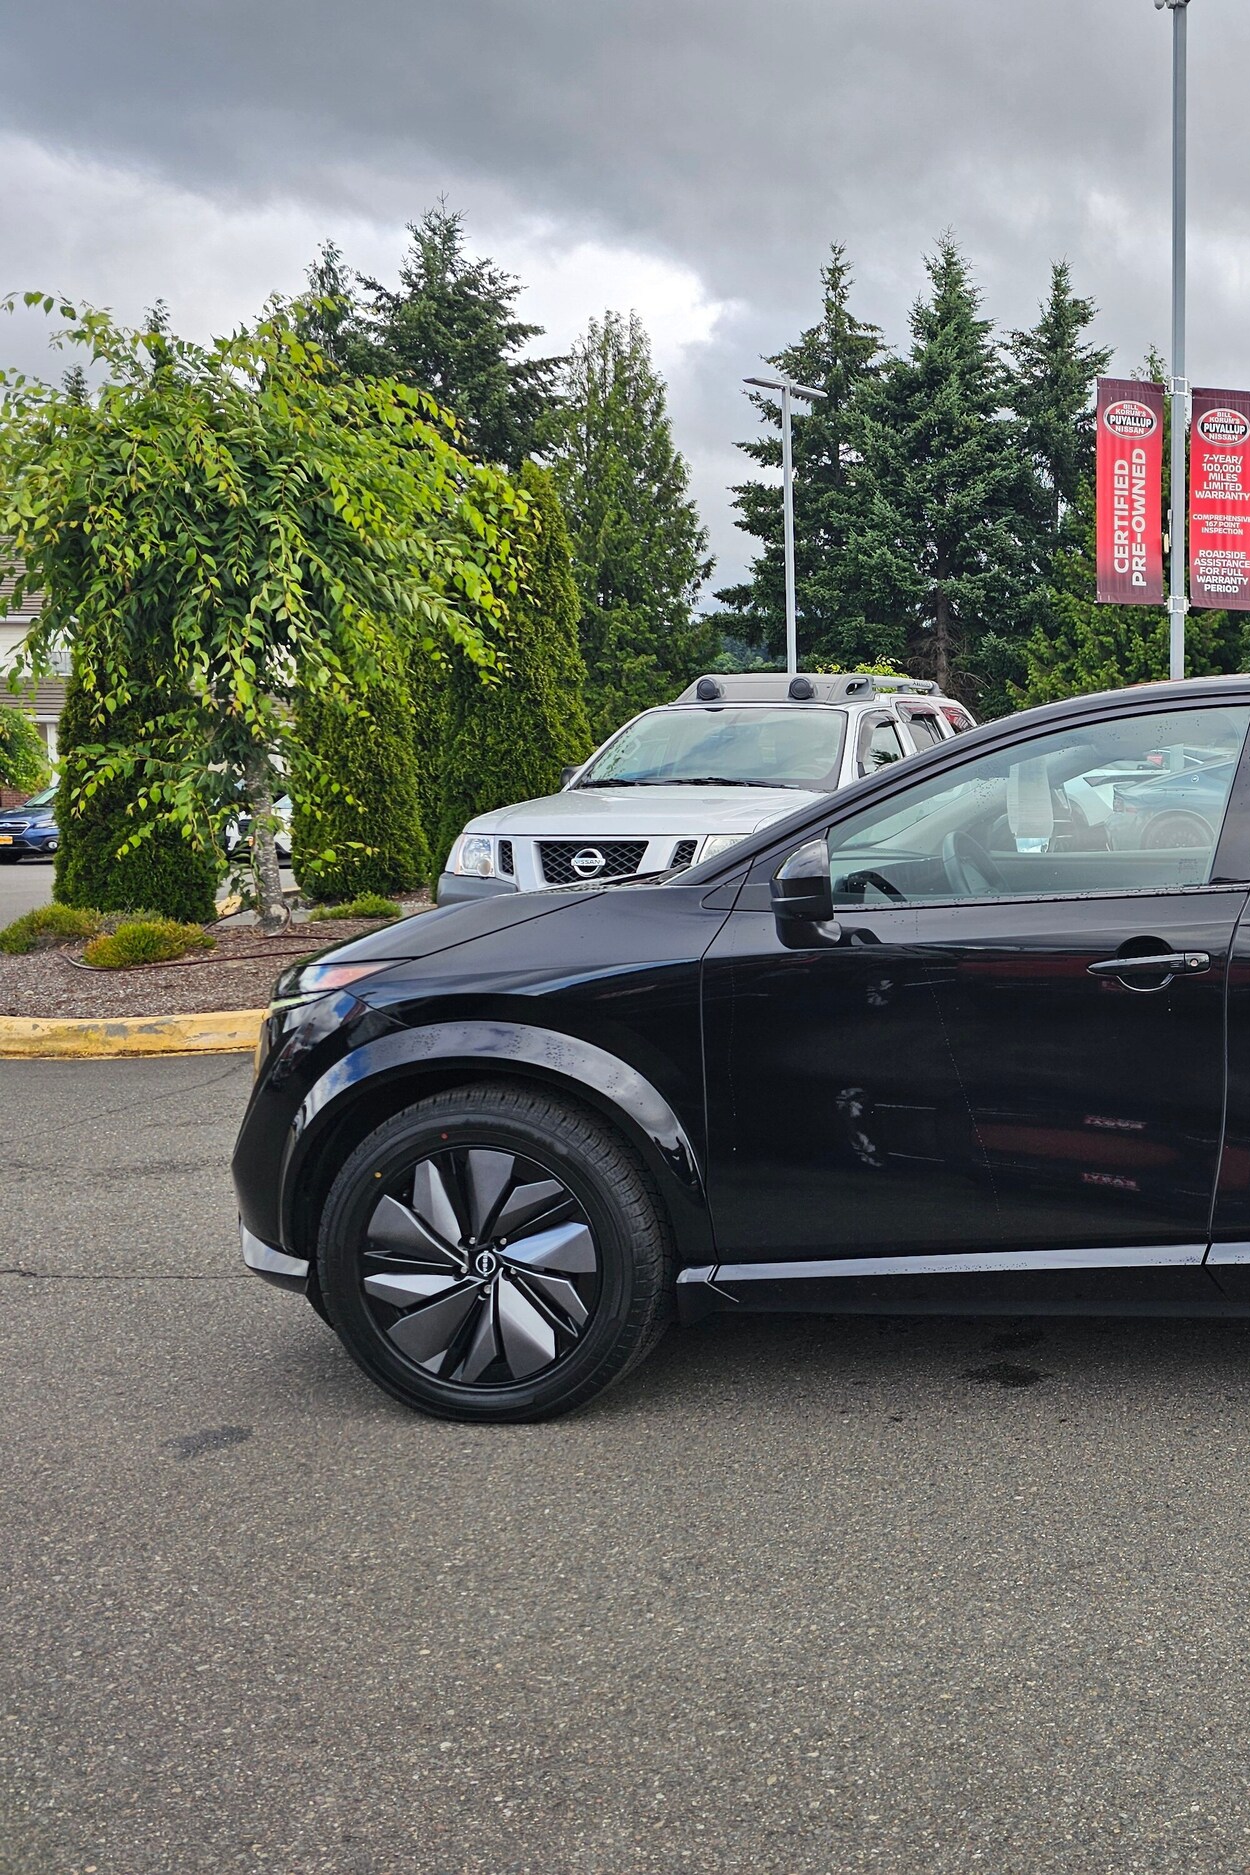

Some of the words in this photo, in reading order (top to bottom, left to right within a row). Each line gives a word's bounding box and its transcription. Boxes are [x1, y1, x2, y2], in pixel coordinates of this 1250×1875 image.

[1109, 415, 1152, 428] PUYALLUP
[1115, 425, 1145, 435] NISSAN
[1203, 423, 1246, 435] PUYALLUP
[1209, 433, 1238, 441] NISSAN
[1203, 454, 1243, 465] 7-YEAR/
[1202, 463, 1242, 473] 100,000
[1208, 473, 1238, 482] MILES
[1203, 482, 1242, 491] LIMITED
[1195, 490, 1250, 501] WARRANTY
[1114, 459, 1129, 574] CERTIFIED
[1131, 448, 1147, 586] PRE-OWNED
[1201, 527, 1243, 535] INSPECTION
[1199, 550, 1246, 559] ROADSIDE
[1194, 558, 1250, 568] ASSISTANCE
[1200, 567, 1219, 575] FOR
[1221, 568, 1243, 576] FULL
[1196, 575, 1248, 585] WARRANTY
[1204, 584, 1239, 593] PERIOD
